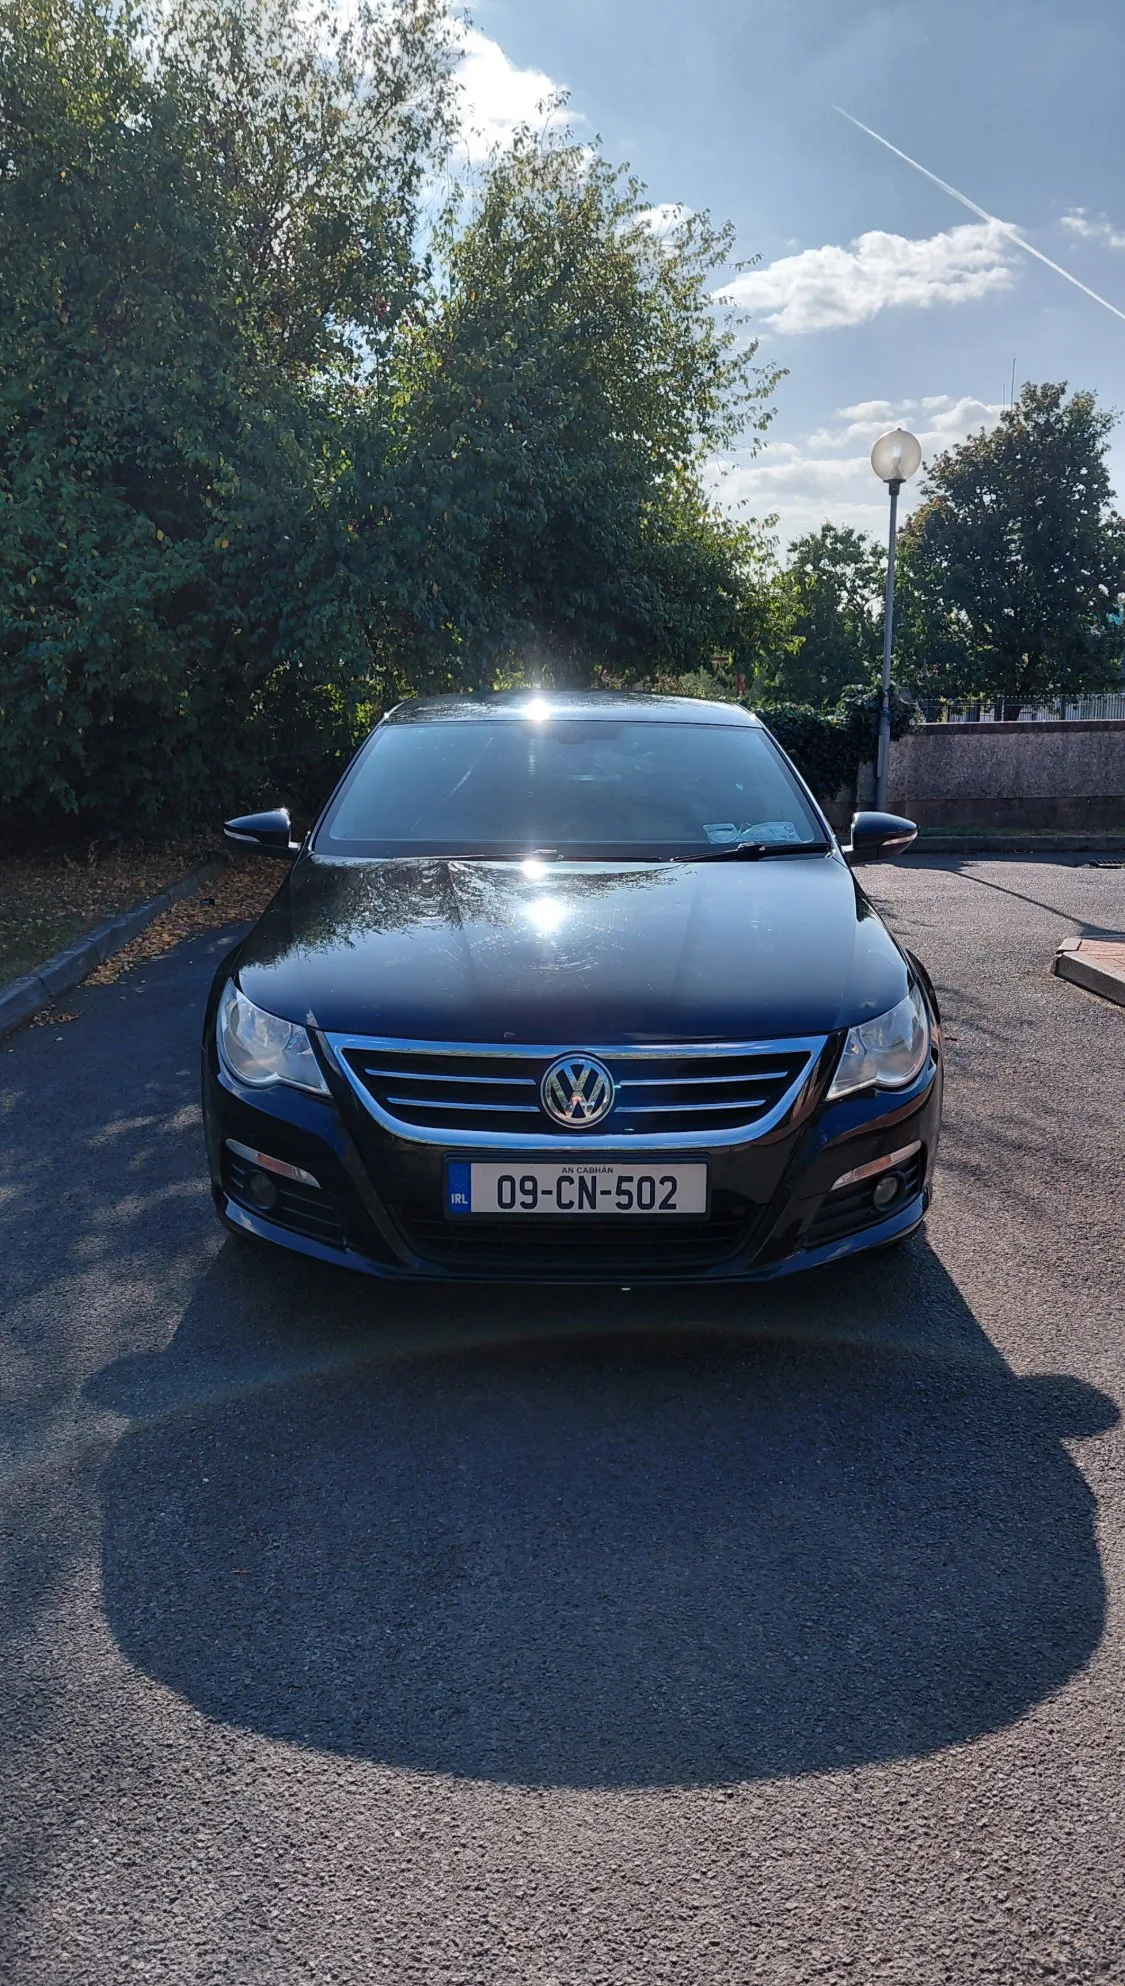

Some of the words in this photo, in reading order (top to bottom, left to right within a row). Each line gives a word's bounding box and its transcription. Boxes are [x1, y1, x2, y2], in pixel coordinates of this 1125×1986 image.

[545, 1058, 611, 1124] VW
[561, 1166, 574, 1174] AN
[576, 1165, 614, 1174] CABHÁN
[451, 1193, 469, 1205] IRL
[497, 1175, 677, 1210] 09-CN-502
